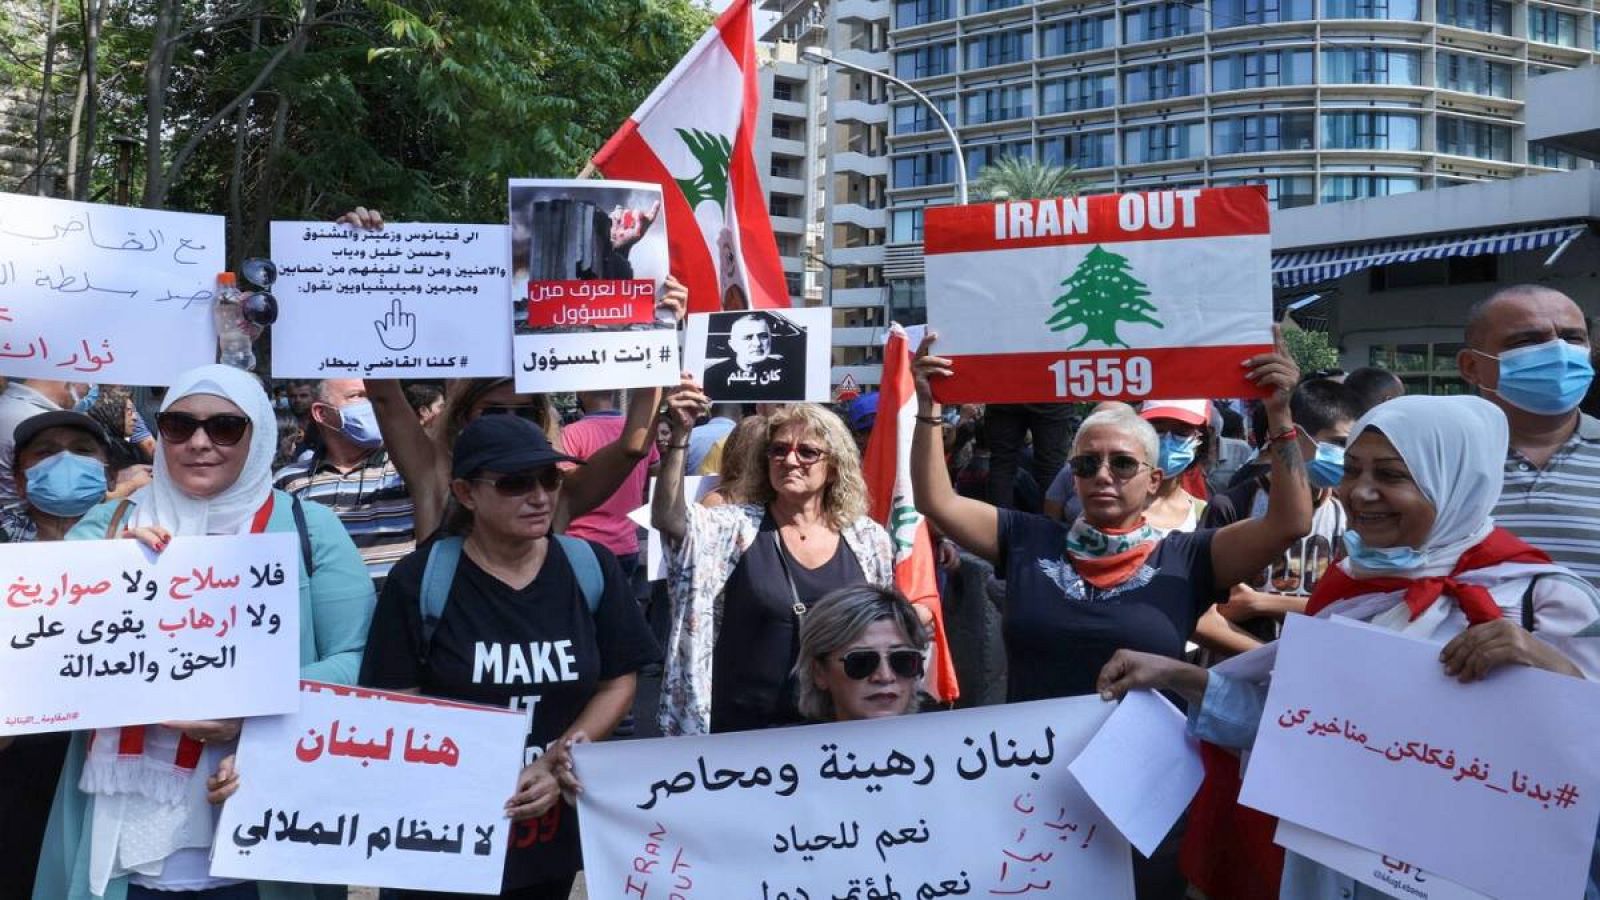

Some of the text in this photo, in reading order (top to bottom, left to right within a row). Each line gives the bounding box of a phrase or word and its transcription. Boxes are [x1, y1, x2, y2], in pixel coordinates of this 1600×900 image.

[995, 191, 1201, 240] IRAN OUT
[302, 228, 360, 243] والمشنوق
[174, 237, 206, 265] مع
[332, 247, 451, 260] وحسن خليل ودياب
[35, 264, 139, 298] سلطة
[278, 264, 507, 278] والامنيين ومن لف لفيفهم من نصابين
[154, 281, 213, 310] ضد
[425, 283, 479, 295] ومجرمين
[530, 280, 654, 301] صرنا نعرف مين
[553, 304, 633, 325] المسؤول
[56, 338, 115, 372] ثوار
[318, 357, 360, 370] بيطار
[363, 355, 422, 373] القاضي
[426, 356, 456, 368] كلنا
[523, 347, 606, 372] المسؤول
[614, 345, 651, 369] إنت
[727, 369, 782, 387] كان يعلم
[1048, 356, 1153, 397] 1559
[7, 562, 285, 608] فلا سلاح ولا صواريخ
[10, 603, 281, 649] ولا ارهاب يقوى على
[59, 650, 160, 682] والعدالة
[472, 639, 579, 684] MAKE
[295, 720, 459, 768] هنا لبنان
[637, 726, 1055, 810] لبنان رهينة ومحاصر
[232, 808, 495, 859] لا لنظام الملالي
[773, 819, 930, 862] نعم للحياد
[624, 820, 668, 900] IRAN
[916, 870, 971, 900] نعم
